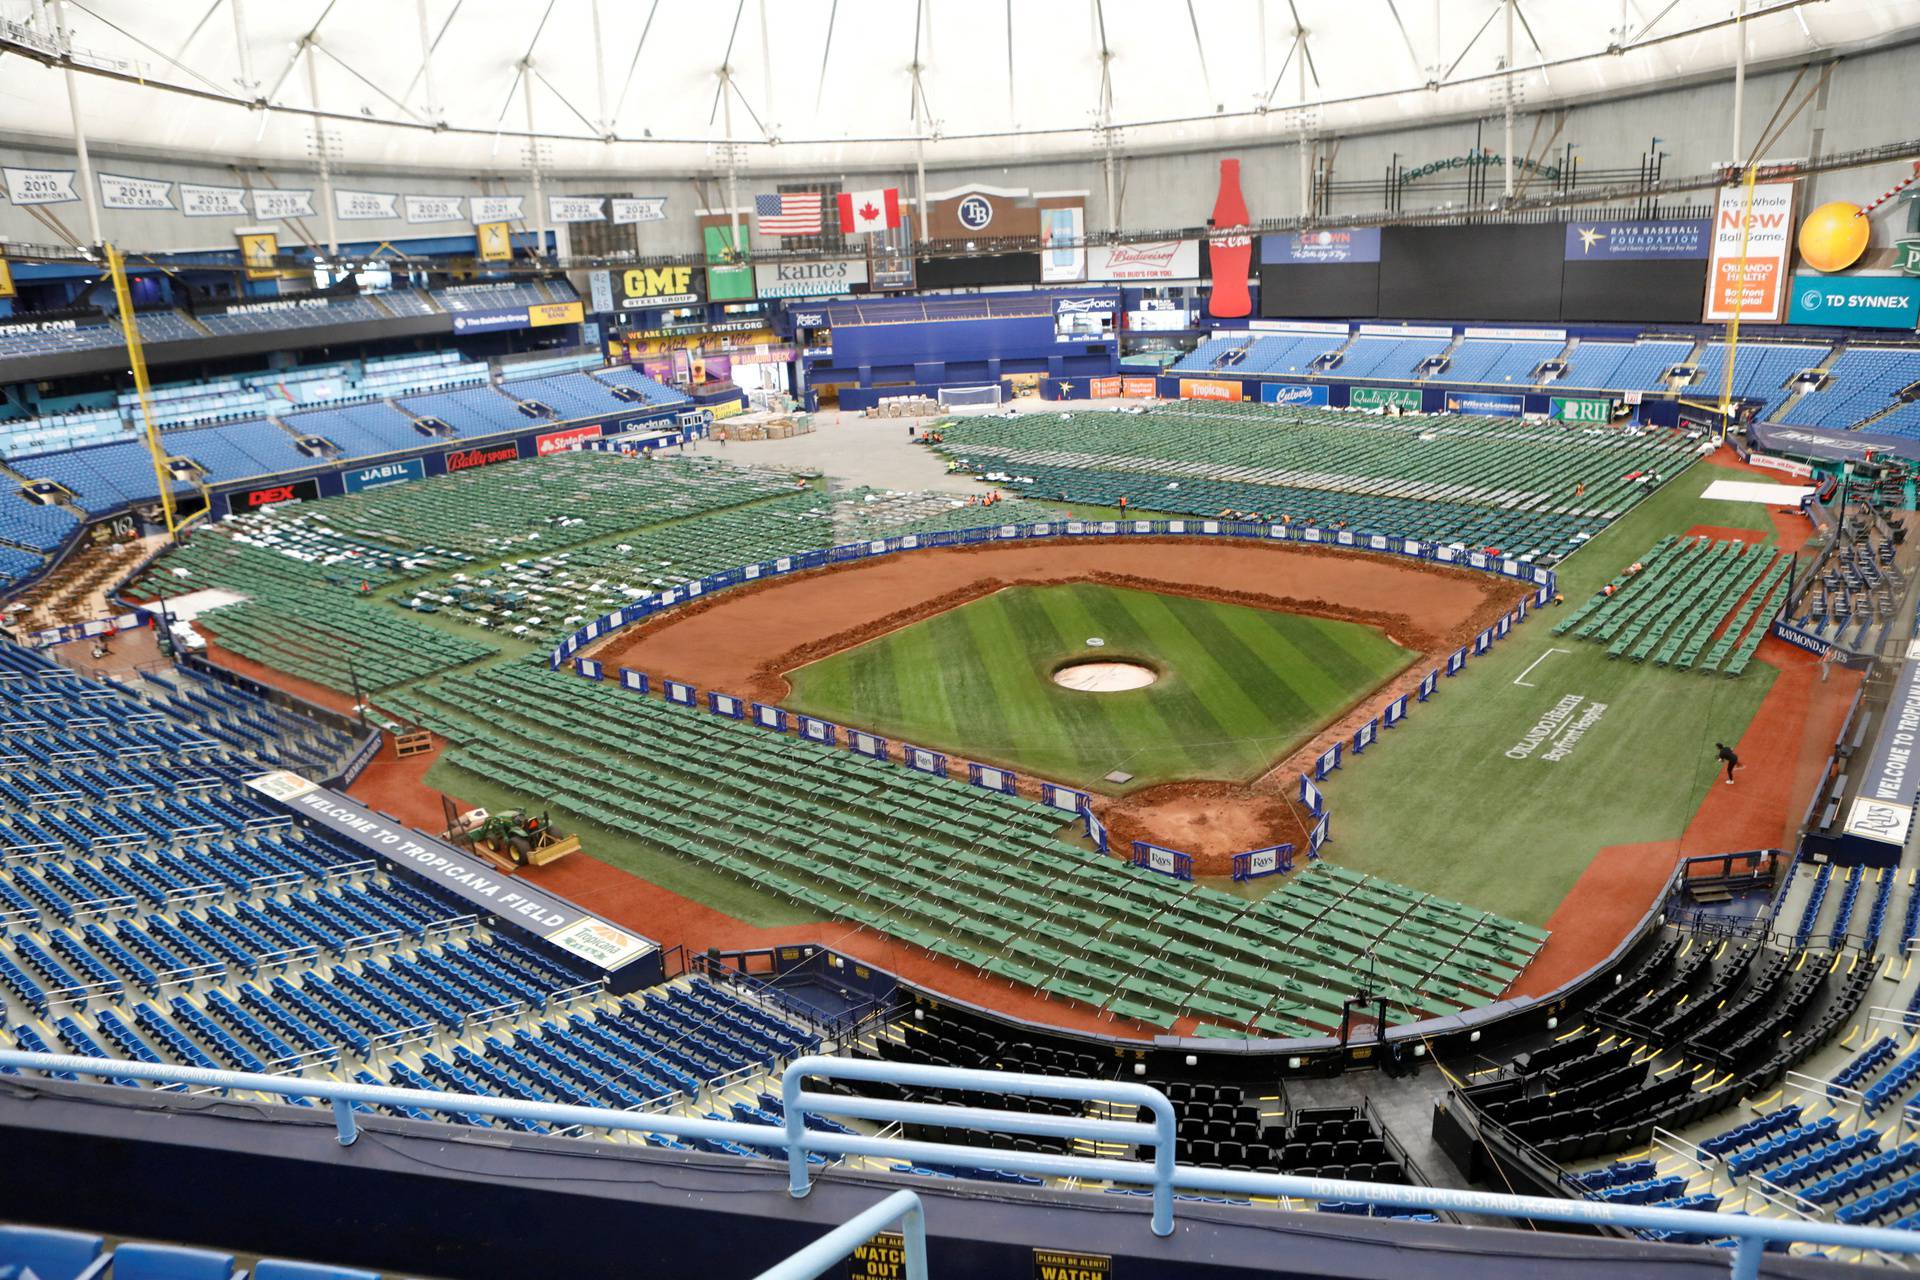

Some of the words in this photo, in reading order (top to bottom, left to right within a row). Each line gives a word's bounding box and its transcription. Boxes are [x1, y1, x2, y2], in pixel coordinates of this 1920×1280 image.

[1400, 154, 1501, 186] TROPICANA
[24, 181, 57, 192] 2010
[120, 187, 152, 198] 2011
[17, 192, 69, 200] CHAMPIONS
[110, 197, 134, 205] WILD
[138, 198, 165, 207] CARD
[198, 196, 228, 206] 2013
[1722, 199, 1738, 207] It's
[1752, 197, 1787, 207] Whole
[190, 204, 211, 212] WILD
[216, 205, 238, 213] CARD
[352, 200, 382, 210] 2020
[419, 204, 448, 213] 2020
[563, 204, 590, 213] 2022
[964, 201, 988, 224] TB
[1721, 209, 1784, 229] New
[1611, 226, 1638, 235] RAYS
[1643, 225, 1699, 235] BASEBALL
[1720, 232, 1742, 241] Ball
[1611, 235, 1698, 244] FOUNDATION
[1110, 250, 1174, 263] Budweiser
[594, 273, 607, 284] 42
[1112, 271, 1127, 279] THIS
[1127, 271, 1146, 279] BUD'S
[624, 266, 692, 298] GMF
[1725, 288, 1764, 297] Bafront
[227, 298, 329, 314] MAINTENX.COM
[628, 297, 657, 306] STEEL
[661, 294, 692, 303] GROUP
[1090, 299, 1116, 309] PORCH
[1725, 297, 1762, 306] Hopital
[1826, 295, 1845, 306] TD
[1848, 295, 1909, 308] SYNNEX
[541, 305, 571, 314] REPUBLIC
[547, 312, 566, 320] BANK
[467, 317, 479, 326] The
[797, 318, 823, 328] PORCH
[628, 331, 642, 339] WE
[644, 329, 660, 338] ARE
[712, 320, 763, 333] STPETE.ORG
[1192, 383, 1230, 398] Tropicana
[1276, 386, 1314, 402] Culver's
[1354, 390, 1386, 407] Quality
[626, 418, 670, 431] Spectrum
[447, 449, 488, 471] Bally
[487, 447, 517, 462] SPORTS
[360, 464, 409, 482] JABIL
[248, 484, 295, 506] DEX
[112, 516, 134, 537] 162
[1778, 627, 1819, 651] RAYMOND
[1819, 645, 1848, 664] JAES
[1505, 720, 1557, 759] ORLANDO
[1542, 694, 1584, 723] HEALTH
[1893, 732, 1915, 748] TO
[1876, 752, 1911, 800] WELCOME
[1854, 805, 1900, 836] RAYS
[301, 793, 380, 833] WELCOME
[372, 829, 400, 845] TO
[397, 841, 502, 897] TROPICANA
[497, 892, 565, 927] FIELD
[1151, 853, 1173, 867] RAYS
[1252, 856, 1274, 869] RAYS
[575, 927, 622, 955] Tropicana
[1312, 1180, 1332, 1195] DO
[1334, 1183, 1361, 1198] NOT
[1403, 1190, 1421, 1202] SIT
[1453, 1194, 1473, 1208] OR
[1475, 1196, 1520, 1211] STAND
[1039, 1255, 1066, 1265] PLEASE
[1080, 1259, 1107, 1269] ALERT!
[867, 1261, 899, 1277] OUT
[1041, 1266, 1103, 1280] WATCH
